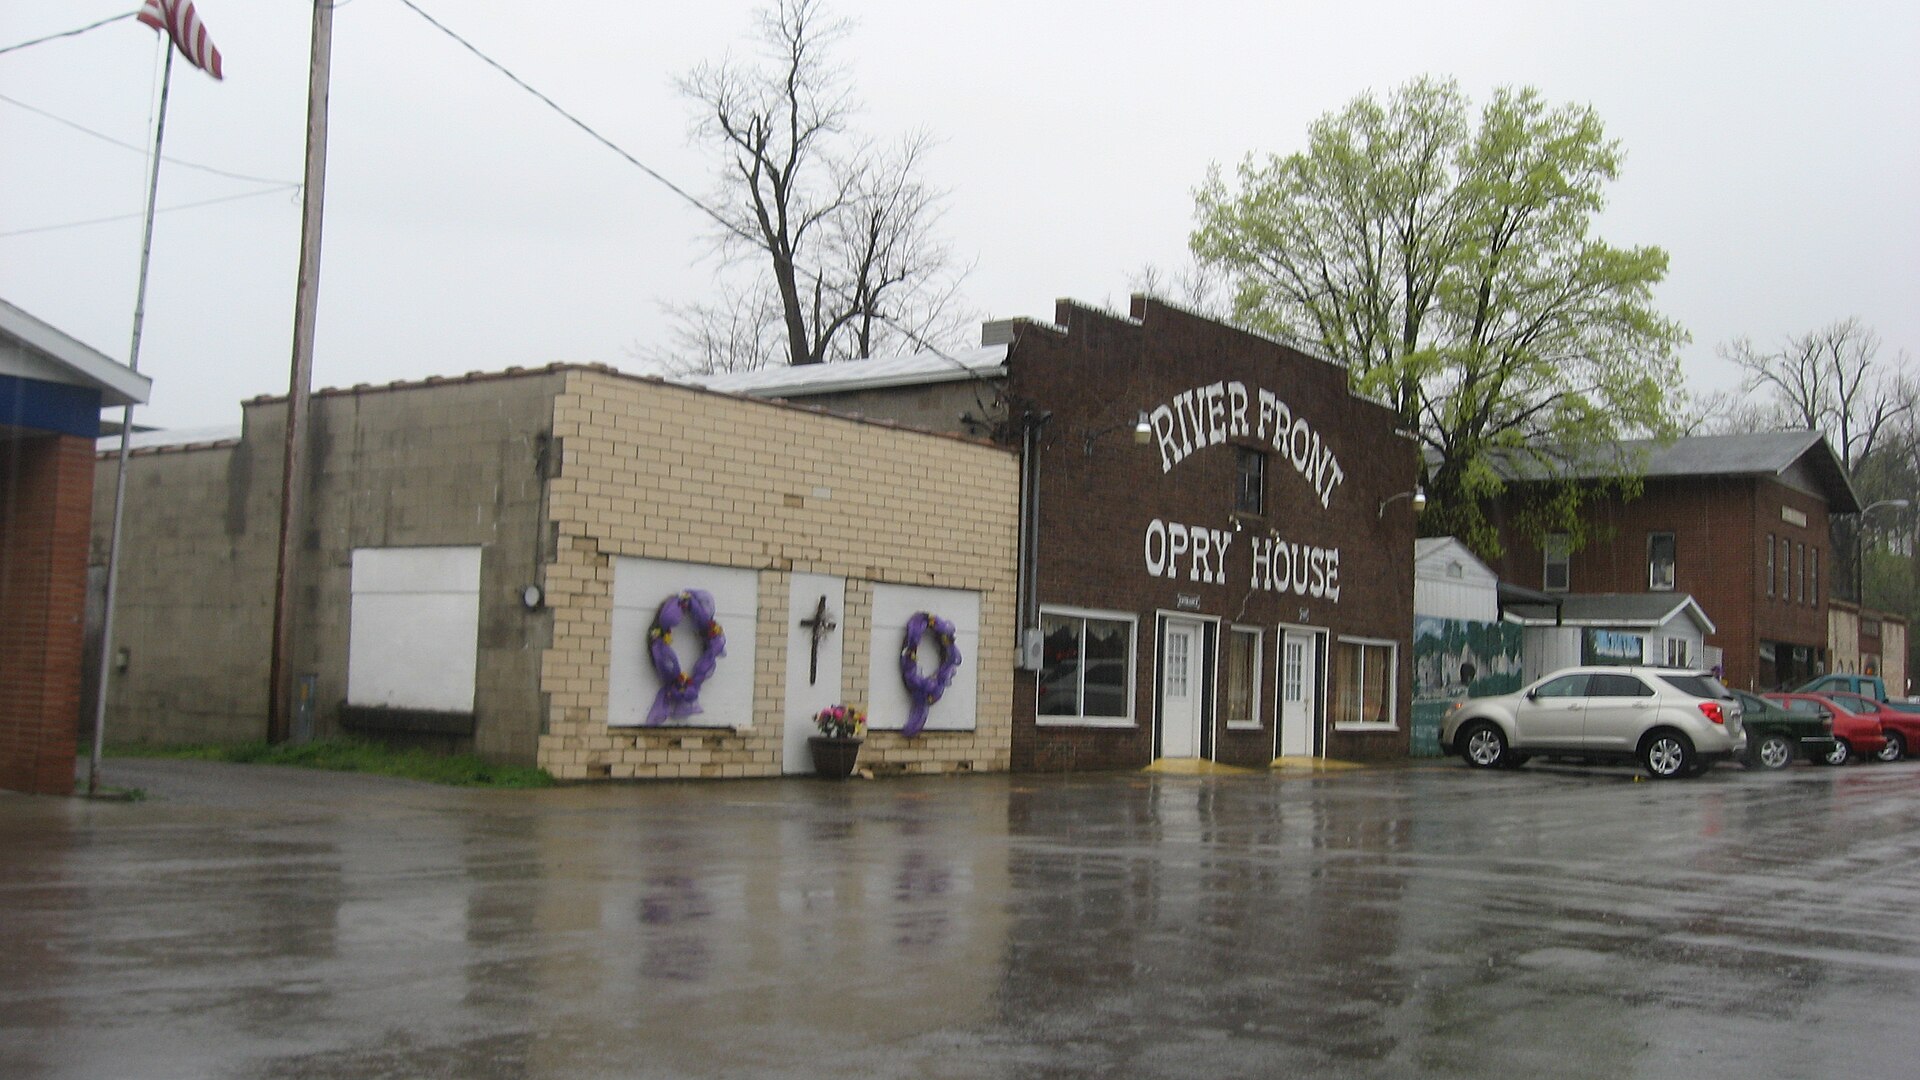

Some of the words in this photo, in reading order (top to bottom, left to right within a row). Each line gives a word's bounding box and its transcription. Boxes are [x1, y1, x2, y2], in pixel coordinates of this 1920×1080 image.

[1150, 381, 1249, 473] RIVER
[1258, 387, 1344, 509] FRONT
[1145, 518, 1232, 585] OPRY
[1250, 536, 1340, 603] HOUSE
